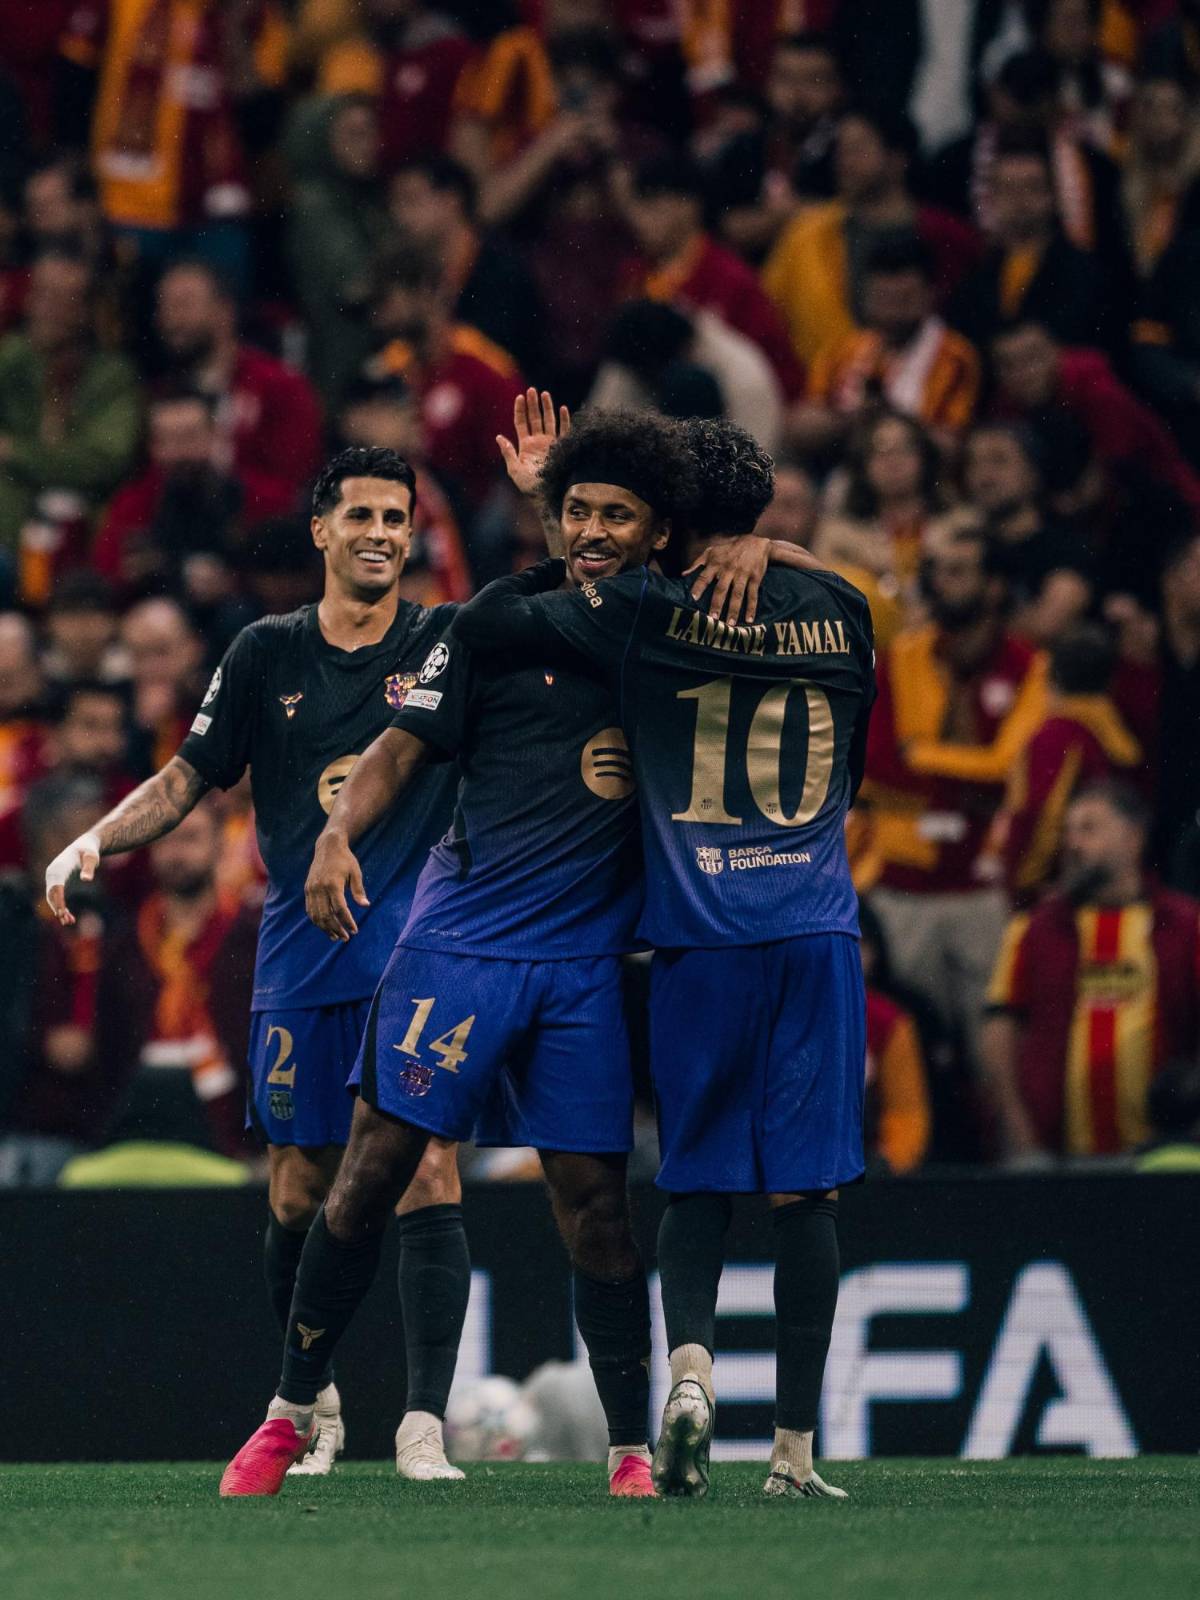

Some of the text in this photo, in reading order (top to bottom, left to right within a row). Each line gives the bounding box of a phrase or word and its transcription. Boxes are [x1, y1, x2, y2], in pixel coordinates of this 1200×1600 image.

[665, 607, 850, 656] LAMINE YAMAL
[671, 674, 835, 827] 10
[728, 845, 772, 858] BARÇA
[730, 852, 811, 871] FOUNDATION
[265, 1023, 297, 1088] 2
[393, 997, 476, 1074] 14
